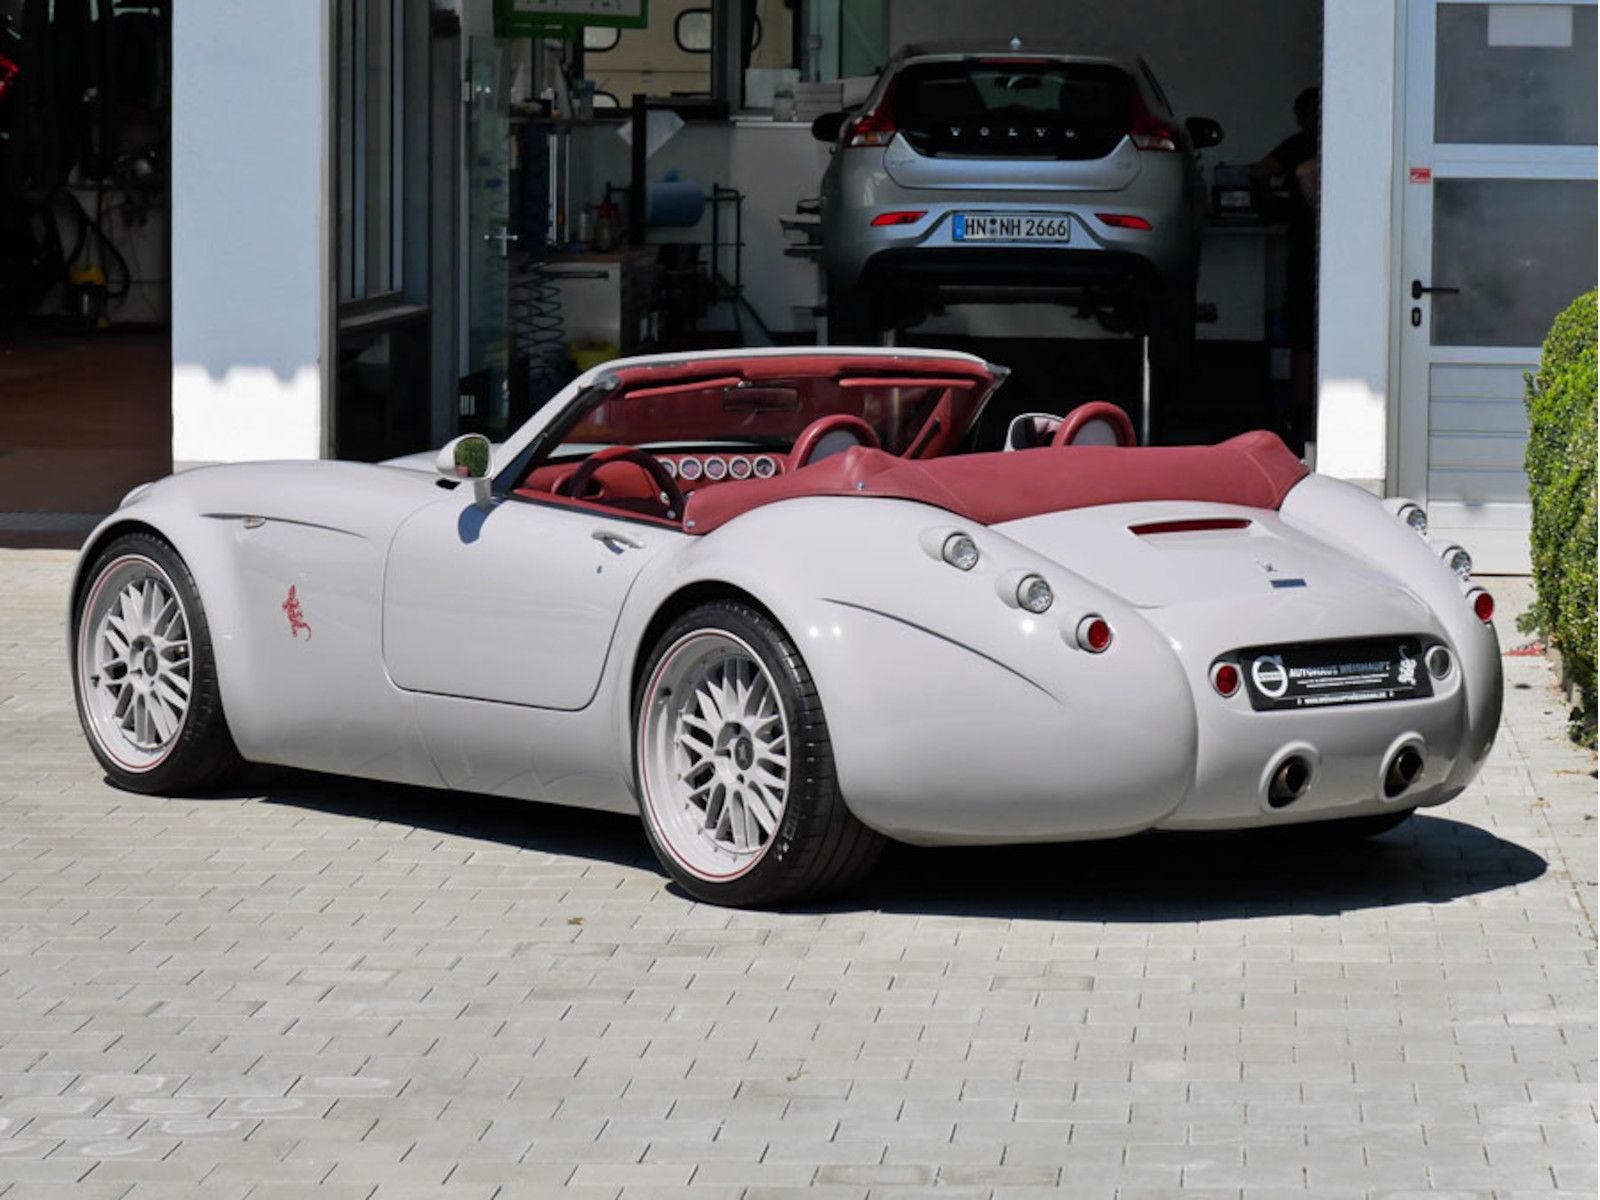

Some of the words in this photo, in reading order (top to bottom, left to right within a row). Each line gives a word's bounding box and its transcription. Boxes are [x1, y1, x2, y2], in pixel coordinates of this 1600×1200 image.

[950, 127, 1076, 138] VOLVO
[965, 218, 987, 236] HN
[999, 218, 1021, 236] NH
[1025, 219, 1066, 237] 2666
[1289, 665, 1338, 678] AUTOHAUS
